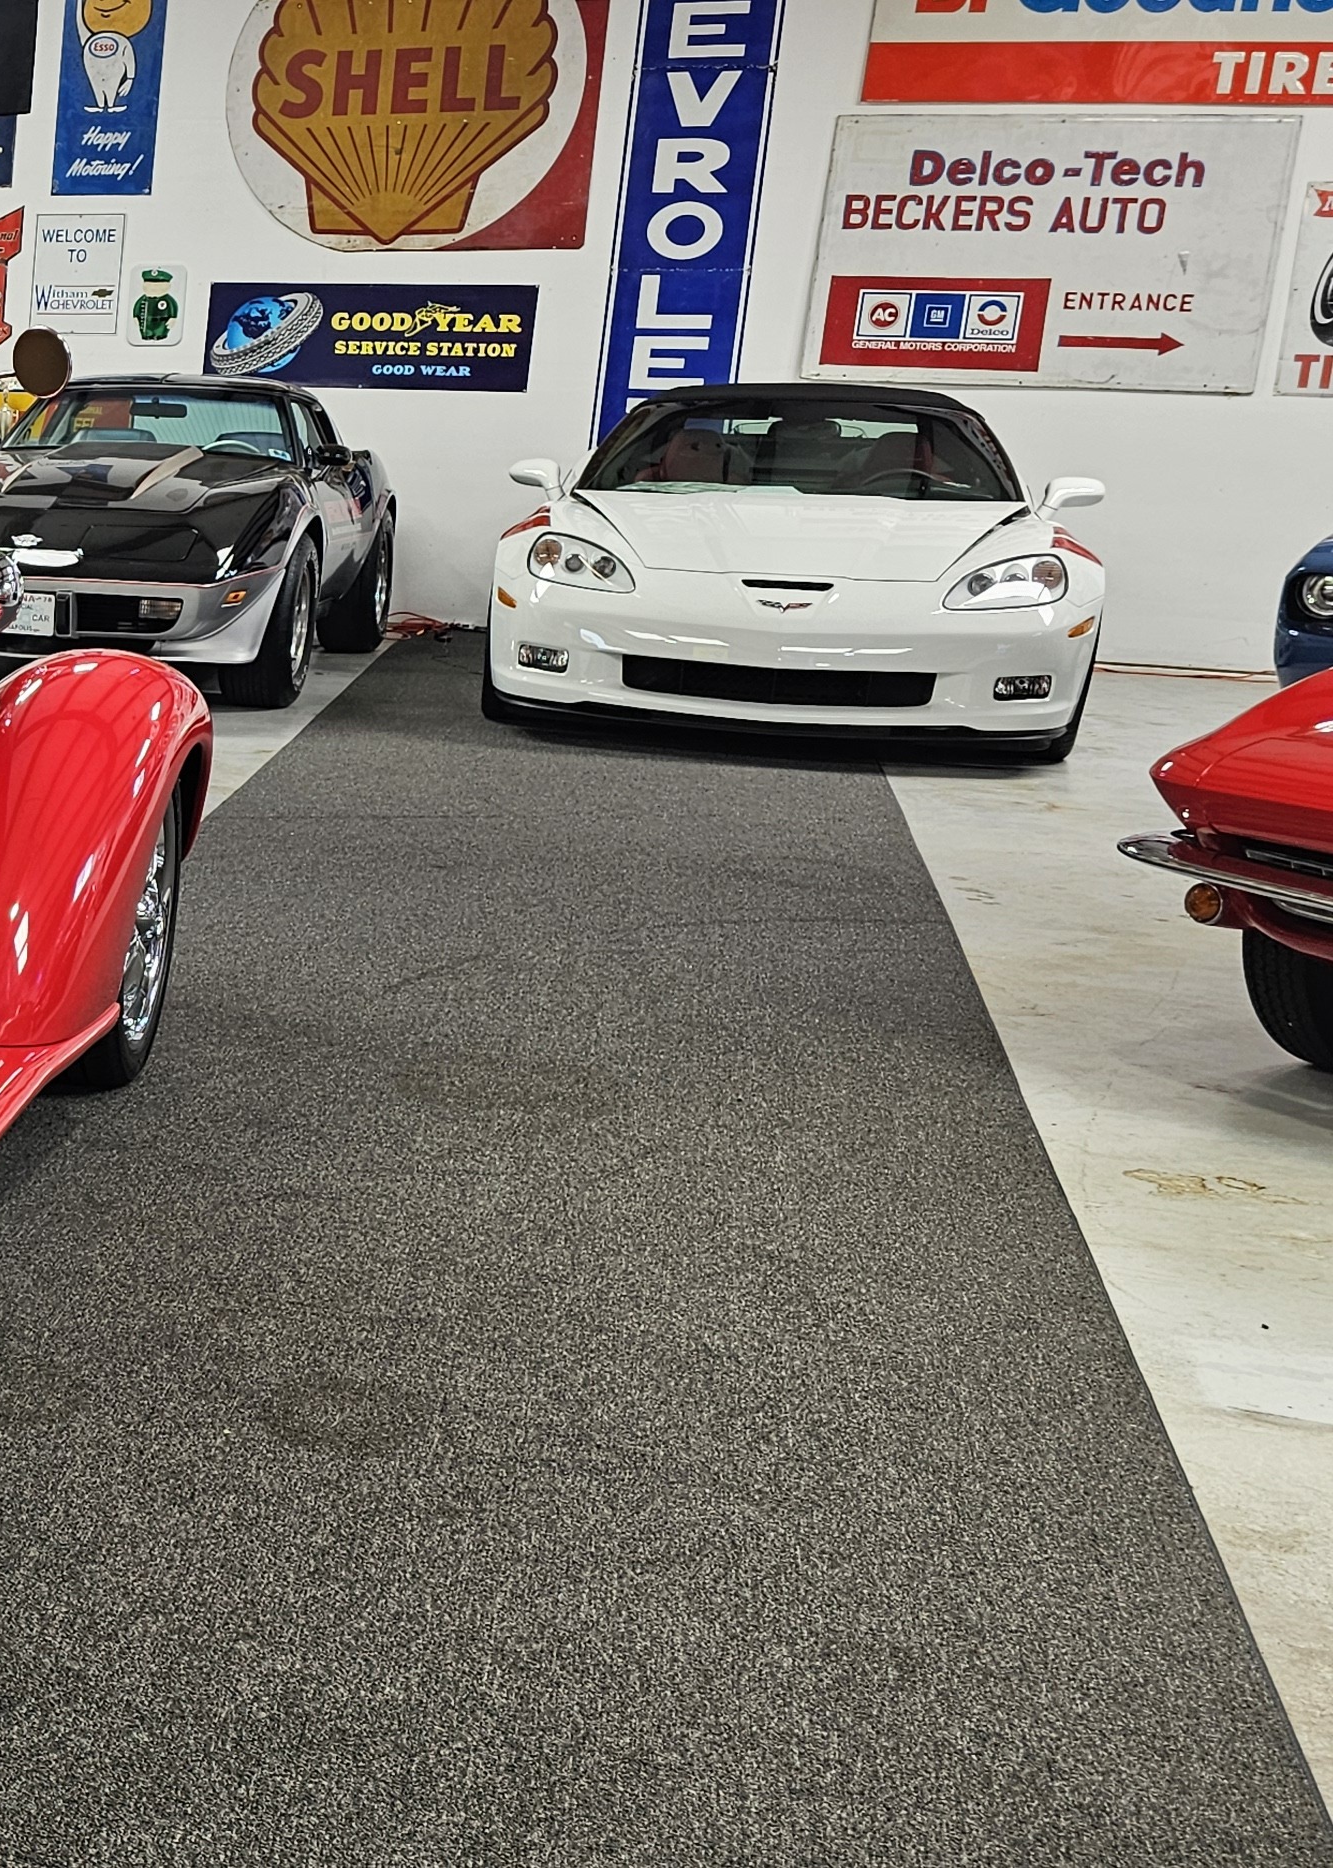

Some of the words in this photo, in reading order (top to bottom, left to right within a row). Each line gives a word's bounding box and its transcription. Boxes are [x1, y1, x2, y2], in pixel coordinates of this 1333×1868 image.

[278, 43, 521, 119] SHELL
[82, 126, 131, 151] Happy
[66, 154, 144, 180] Motoring!
[625, 0, 752, 414] EVROLE
[841, 193, 1034, 232] BECKERS
[1048, 196, 1167, 235] AUTO
[42, 228, 117, 243] WELCOME
[68, 248, 87, 263] TO
[49, 298, 114, 310] CHEVROLET
[1063, 291, 1195, 313] ENTRANCE
[871, 307, 897, 322] AC
[930, 309, 945, 319] GM
[969, 328, 1009, 336] Delco
[334, 340, 422, 356] SERVICE
[425, 342, 518, 357] STATION
[851, 340, 898, 349] GENERAL
[899, 341, 943, 351] MOTORS
[944, 342, 1016, 353] CORPORATION
[371, 364, 416, 376] GOOD
[420, 365, 472, 377] WEAR
[32, 613, 50, 622] CAR
